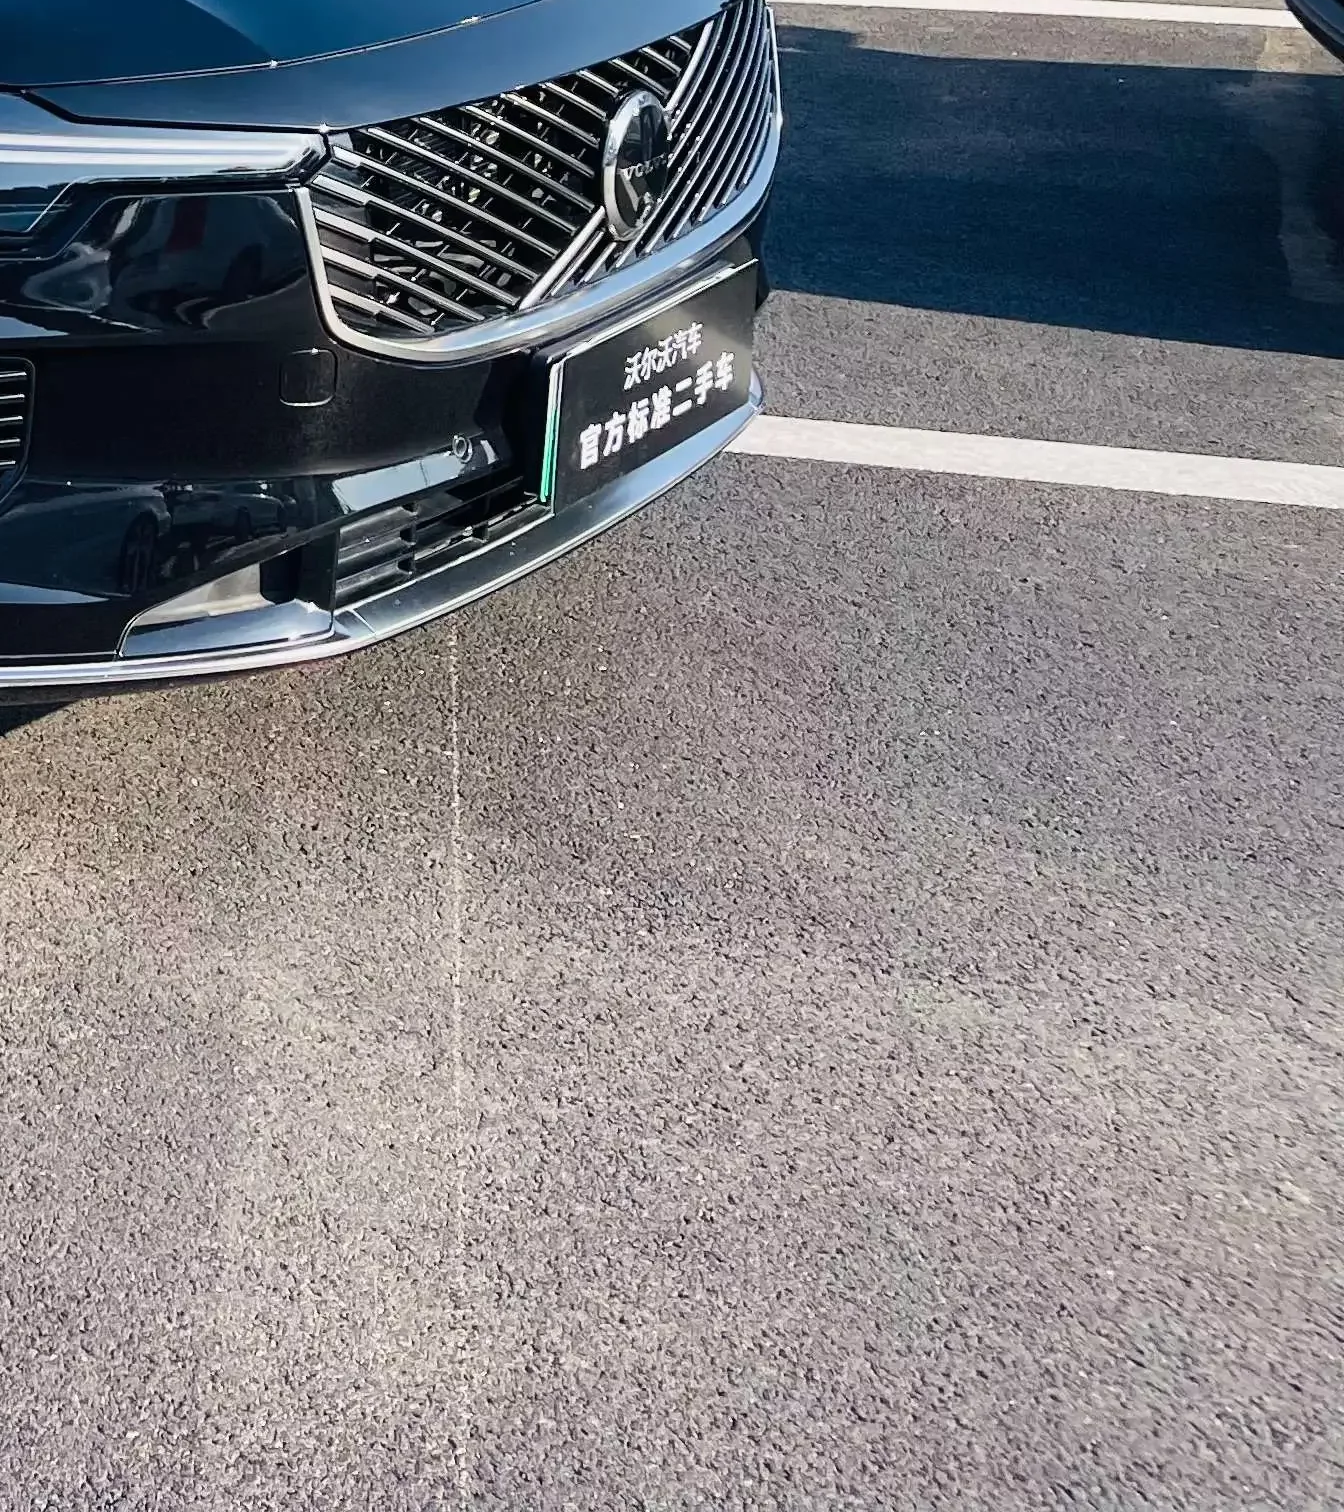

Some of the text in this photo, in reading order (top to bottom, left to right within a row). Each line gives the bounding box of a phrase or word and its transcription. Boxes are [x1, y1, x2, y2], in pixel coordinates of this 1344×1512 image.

[623, 321, 704, 391] 沃尔沃汽车
[579, 351, 735, 471] 官方标准二手车
